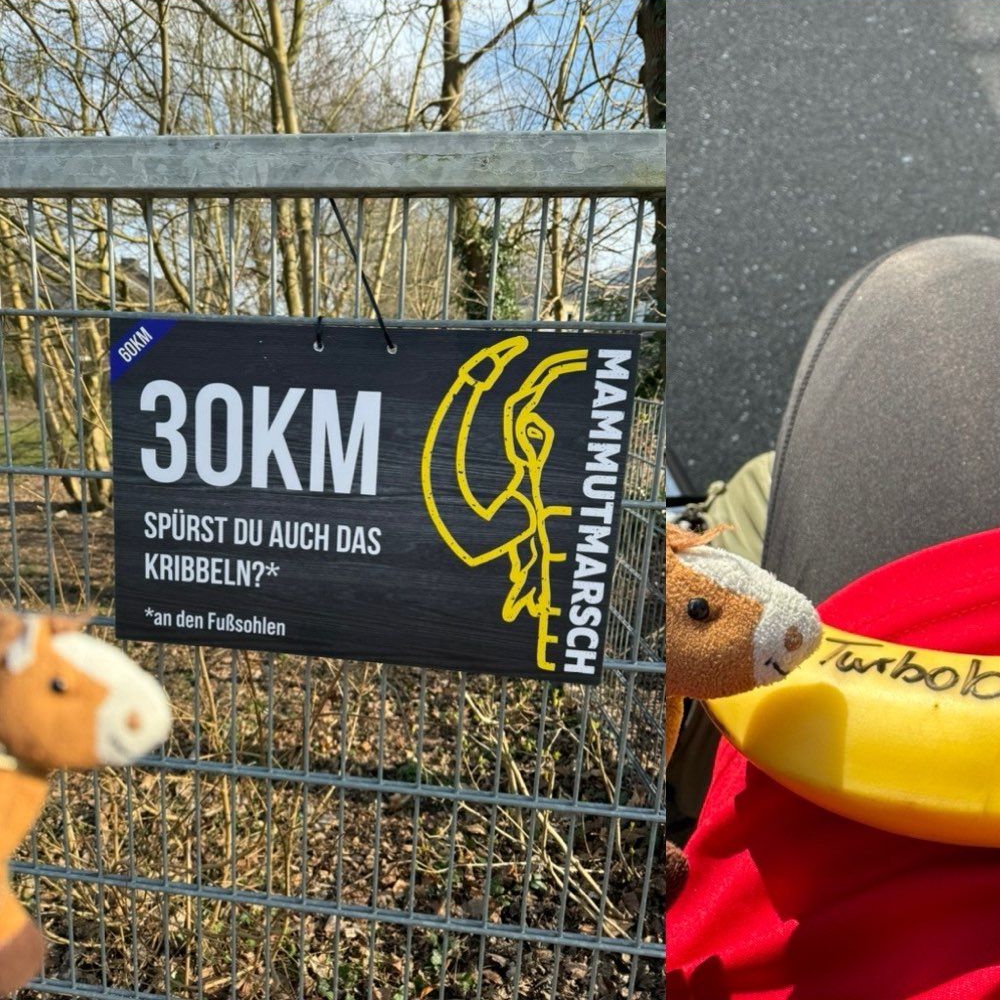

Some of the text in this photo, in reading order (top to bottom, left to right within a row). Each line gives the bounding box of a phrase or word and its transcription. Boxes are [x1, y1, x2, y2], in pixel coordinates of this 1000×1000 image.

[118, 326, 153, 363] 60KM
[140, 379, 382, 496] 30KM
[144, 508, 382, 556] SPÜRST DU AUCH DAS
[563, 348, 632, 676] MAMMUTMARSCH
[176, 609, 204, 629] den
[207, 611, 286, 637] Fußsohlen
